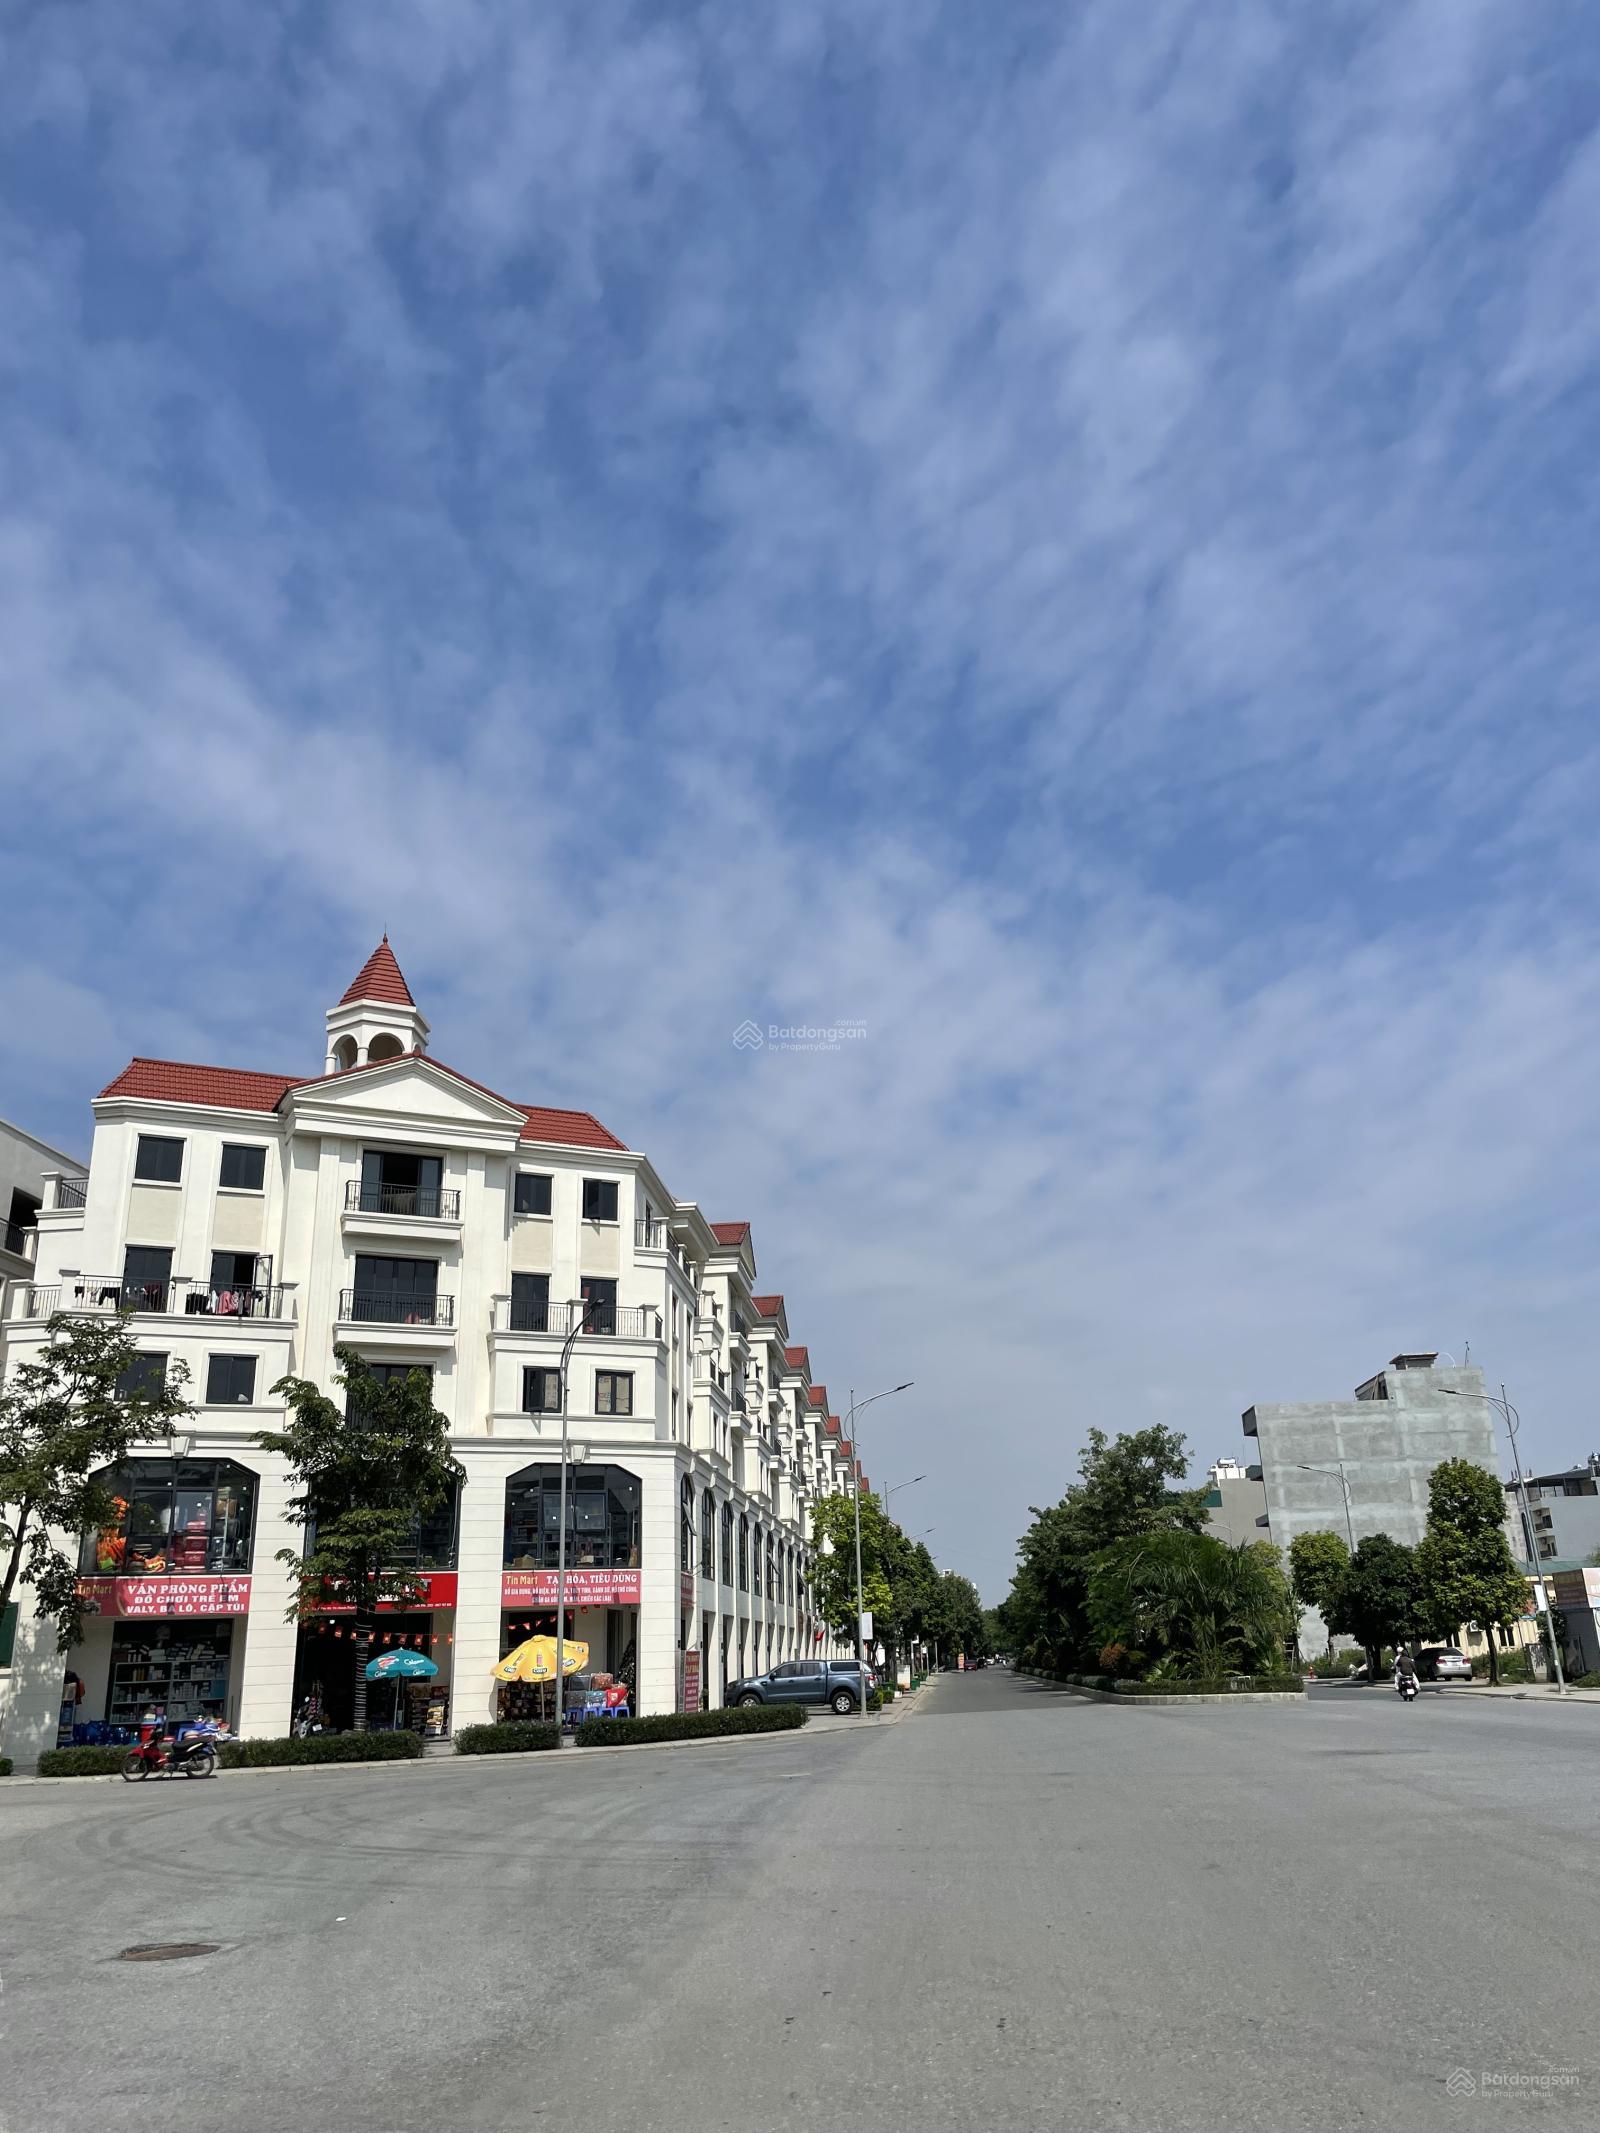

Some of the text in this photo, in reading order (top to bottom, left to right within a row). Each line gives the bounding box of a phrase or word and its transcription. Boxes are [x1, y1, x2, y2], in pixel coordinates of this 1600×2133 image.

[506, 1575, 538, 1585] Tin Mart
[590, 1573, 611, 1583] TIÊU
[160, 1582, 207, 1594] PHÒNG
